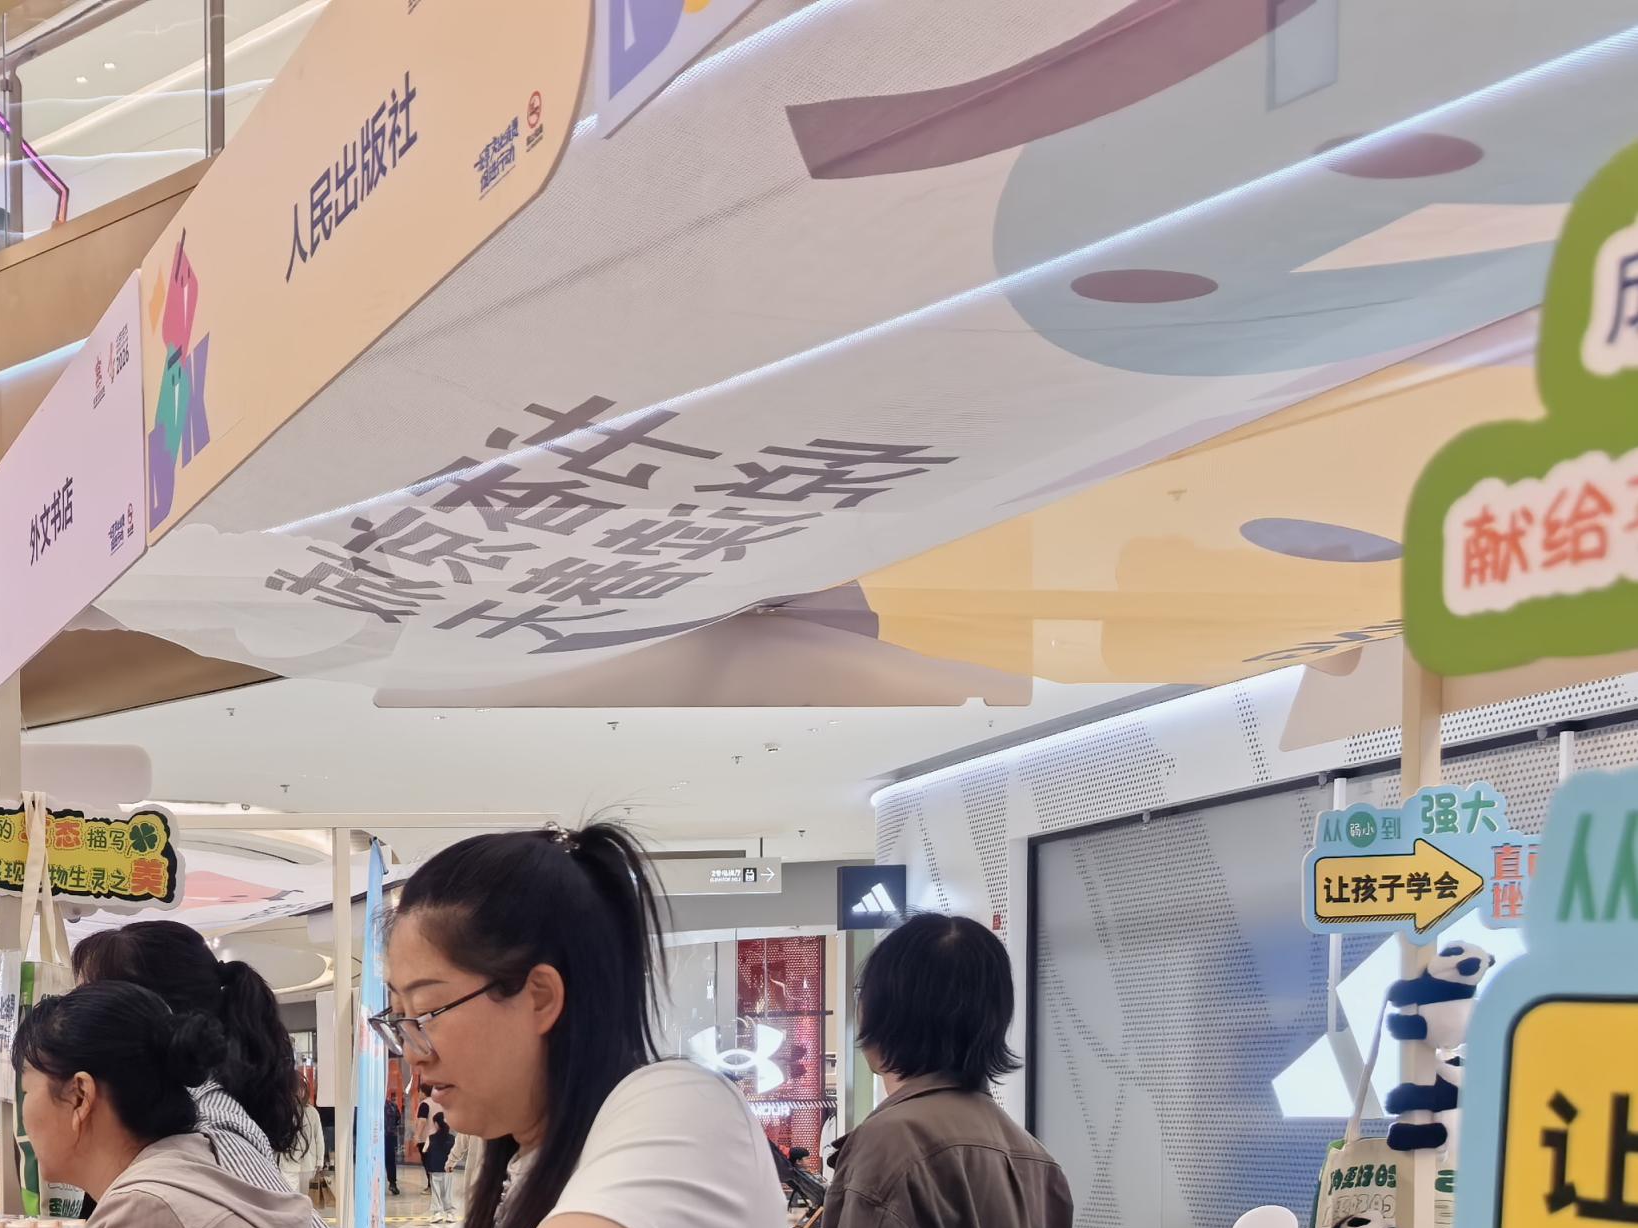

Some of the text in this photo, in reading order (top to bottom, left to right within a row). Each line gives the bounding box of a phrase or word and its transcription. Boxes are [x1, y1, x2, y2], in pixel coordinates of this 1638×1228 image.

[284, 71, 419, 284] 人民出版社
[29, 476, 75, 567] 外文书店
[1462, 477, 1638, 590] 献给
[1323, 870, 1460, 905] 让孩子学会
